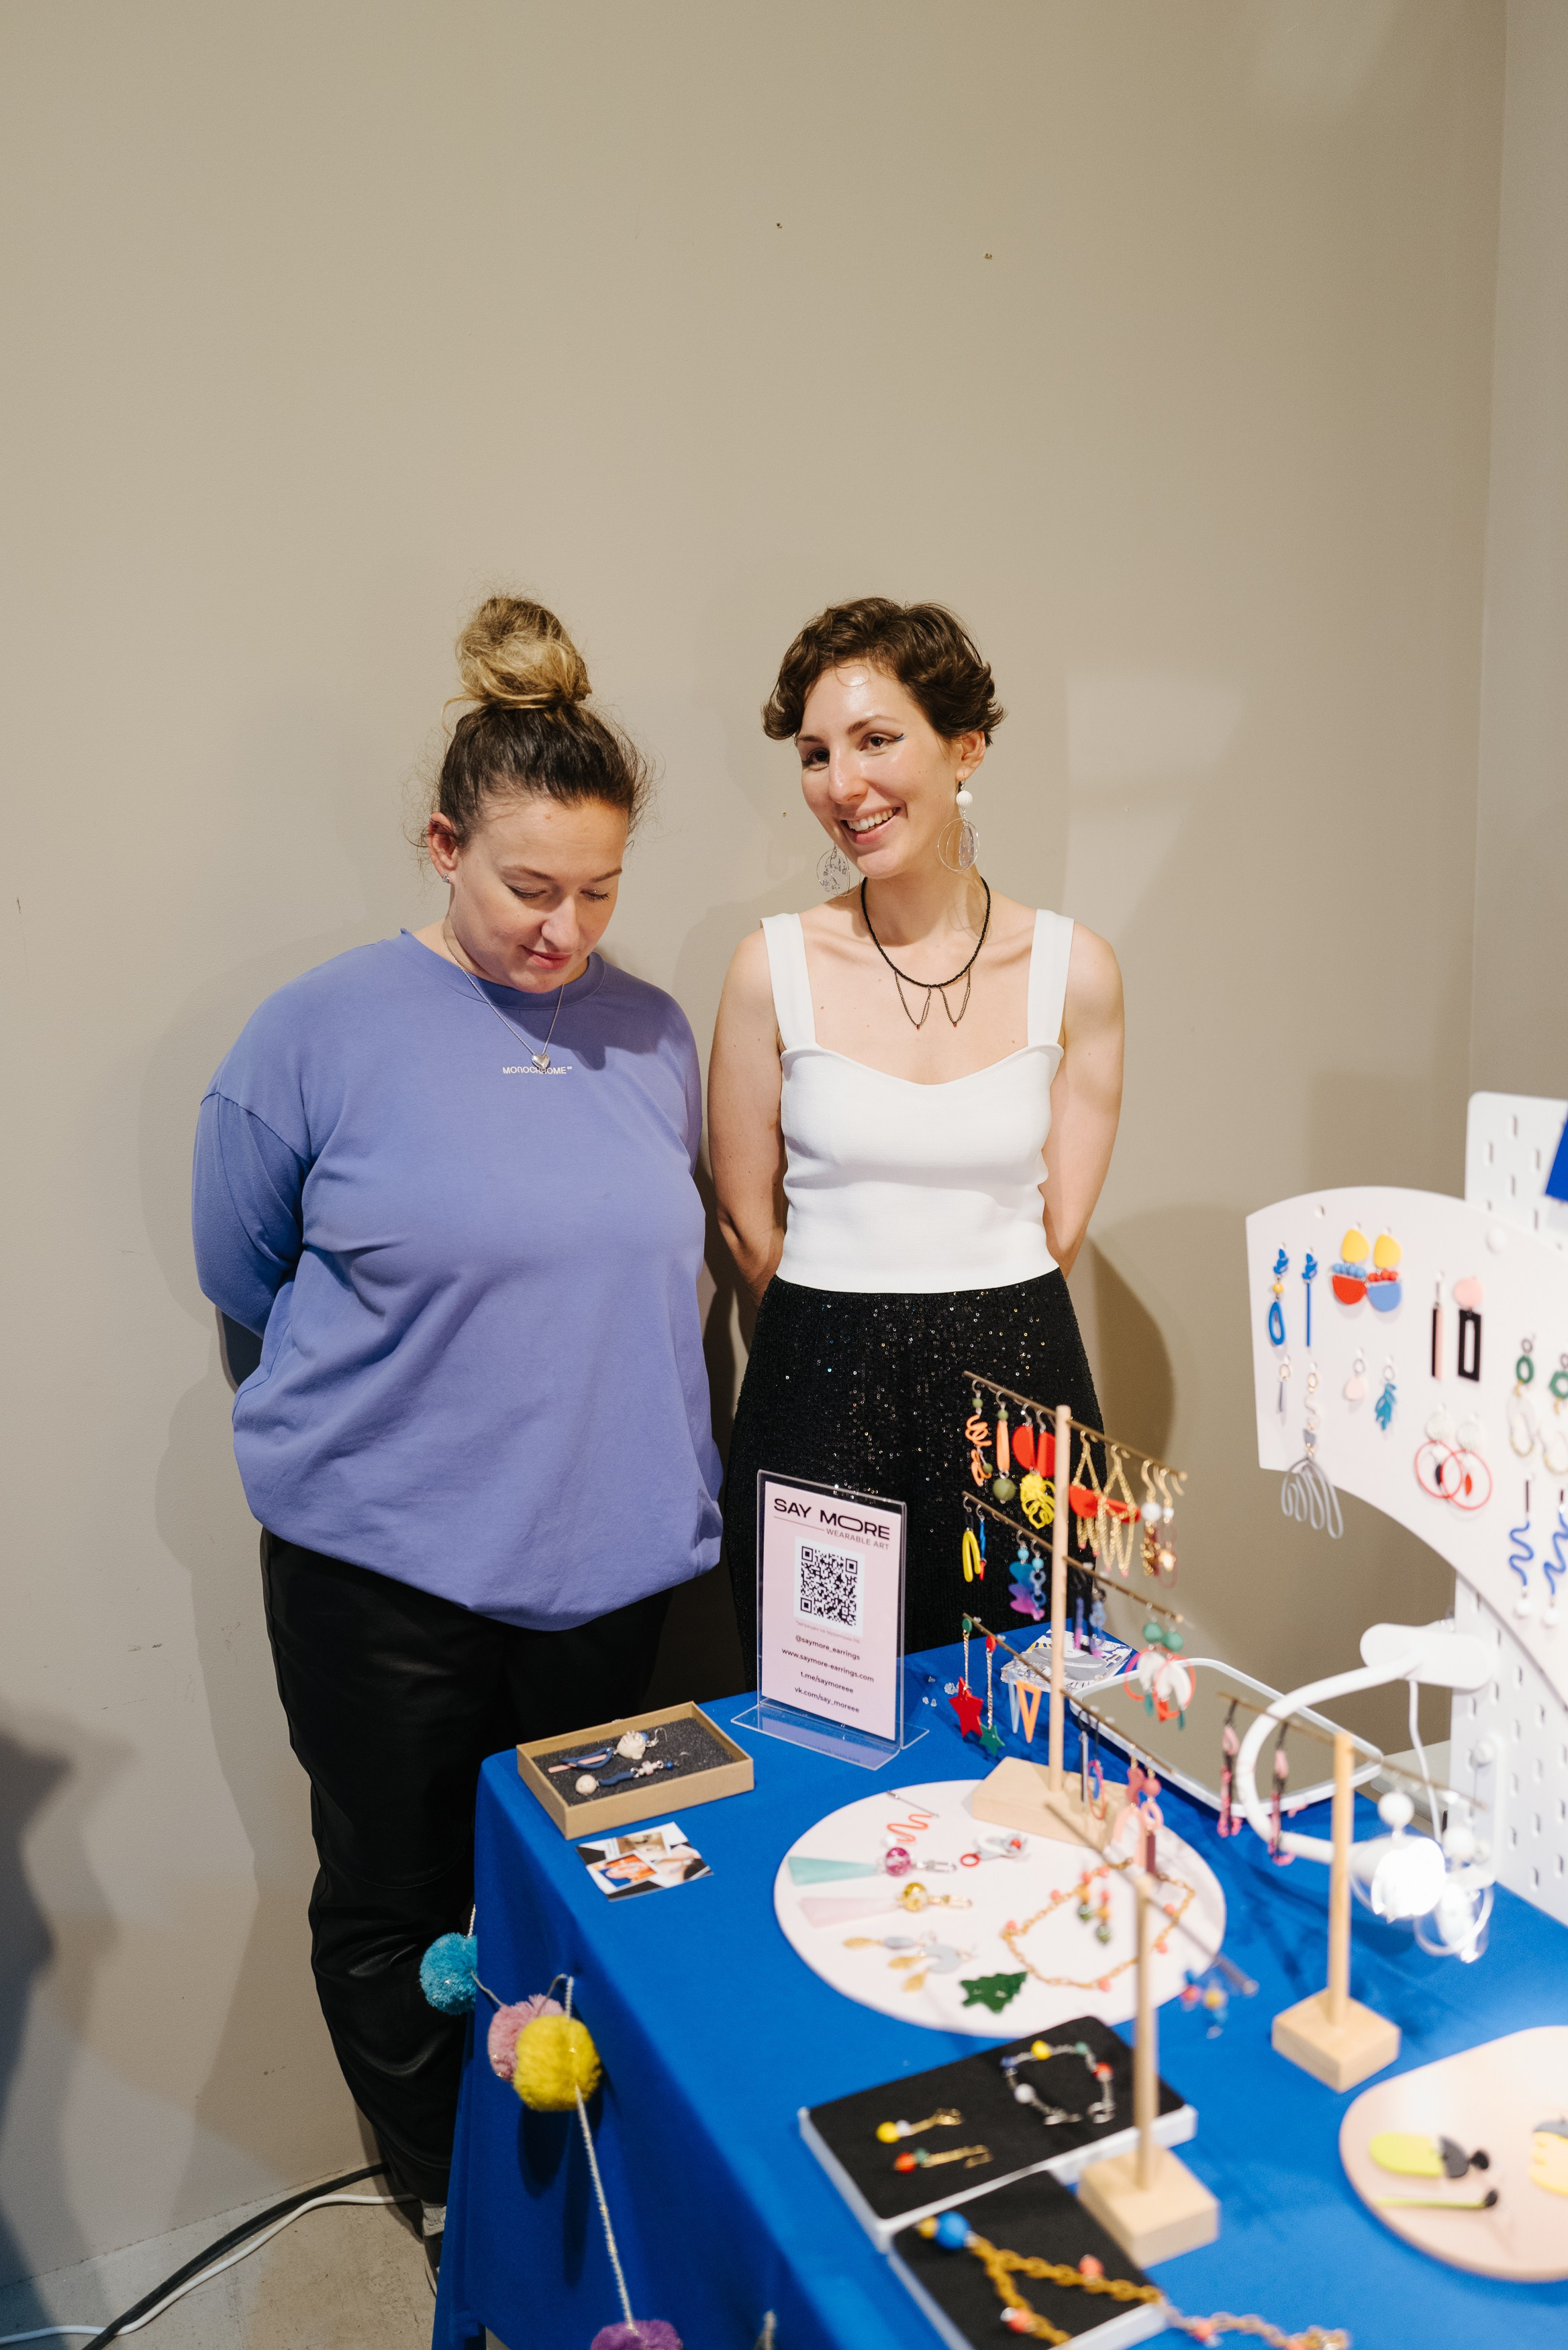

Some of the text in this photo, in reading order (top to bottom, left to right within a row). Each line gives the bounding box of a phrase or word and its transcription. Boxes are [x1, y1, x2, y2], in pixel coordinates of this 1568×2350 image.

[774, 1499, 890, 1540] SAY MORE
[826, 1528, 889, 1550] WEARABLE ART
[795, 1635, 861, 1660] @saymore_earrings
[781, 1648, 875, 1683] www.saymore-earrings.com
[800, 1671, 854, 1694] t.me/saymoreee
[794, 1687, 860, 1713] vk.com/say_moreee
